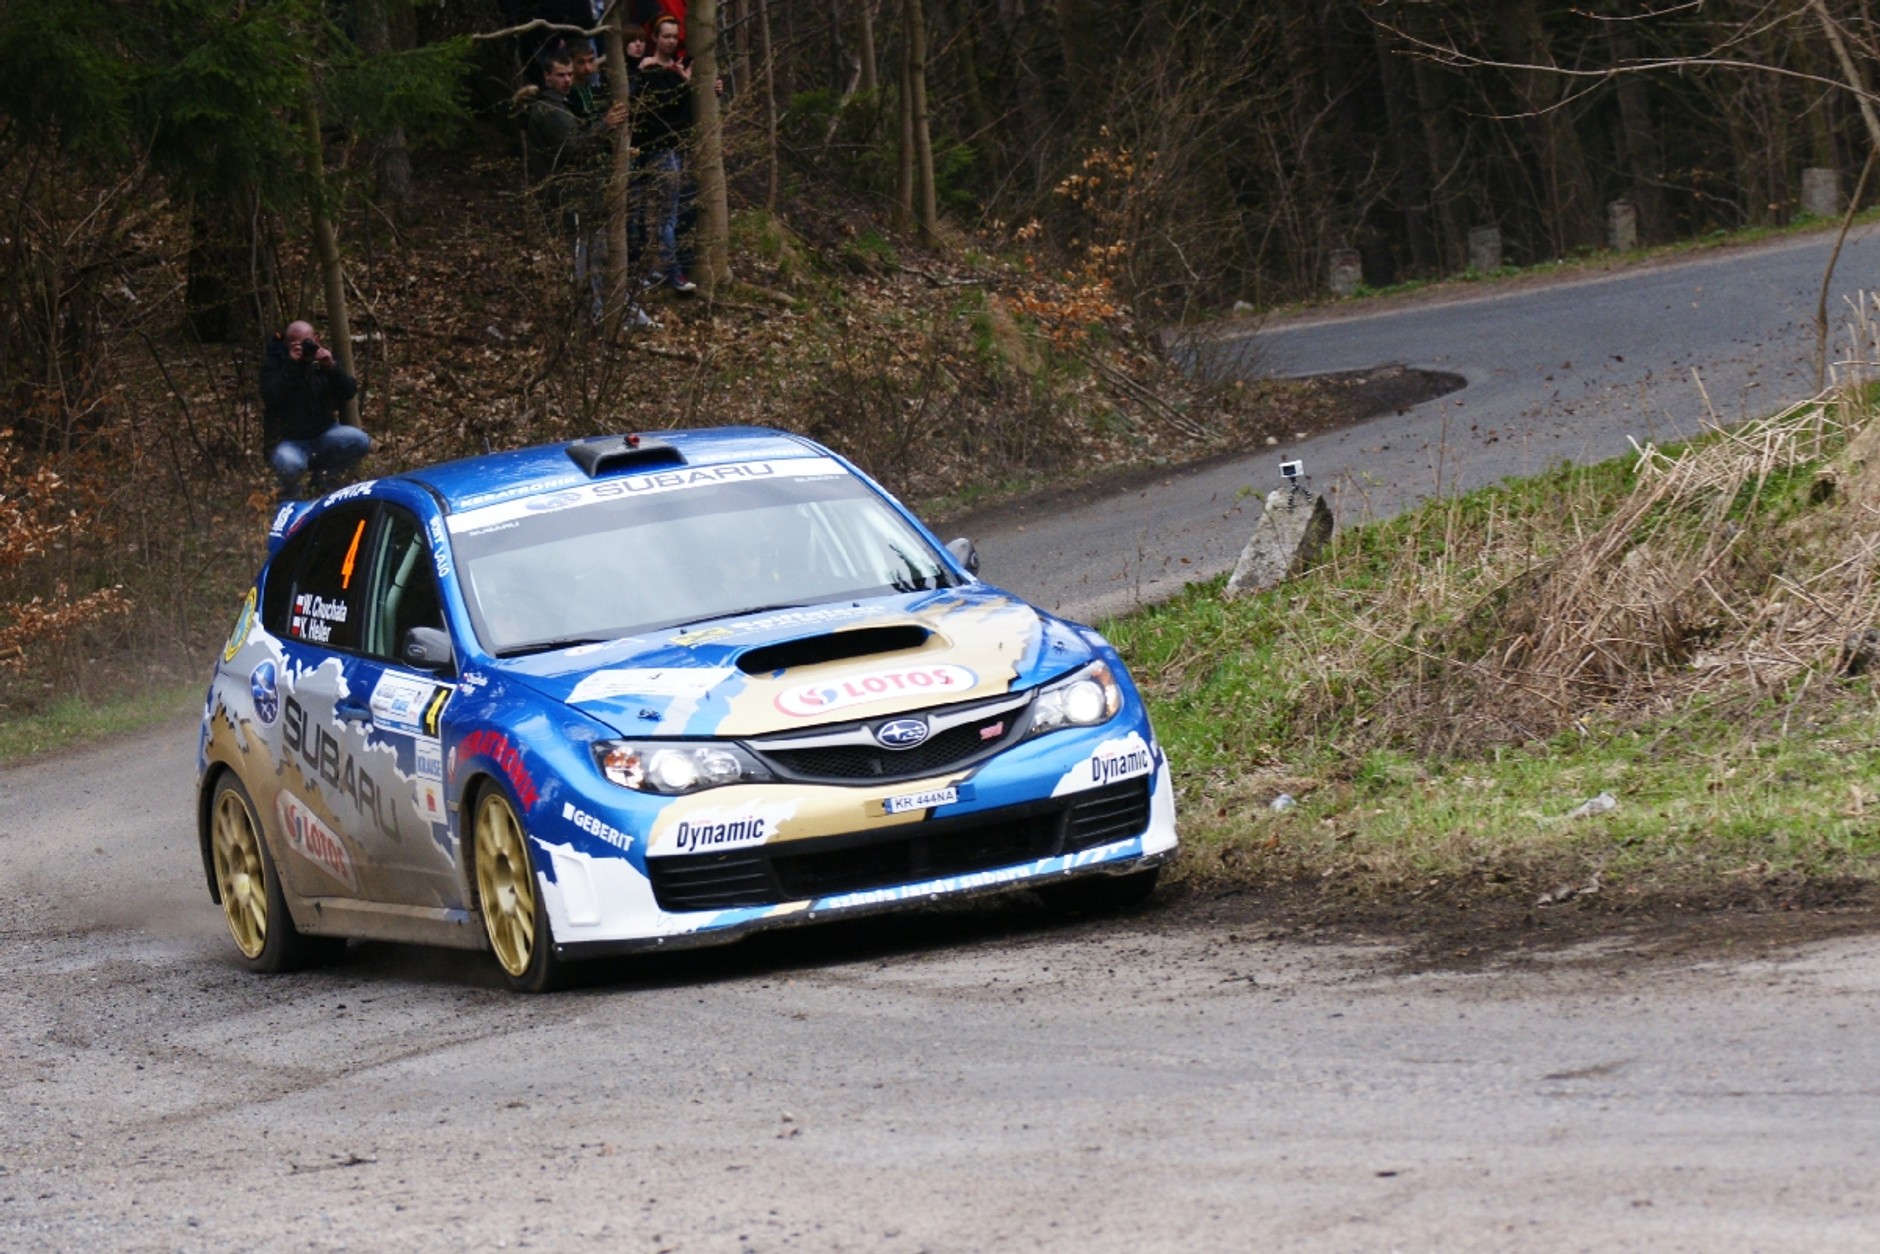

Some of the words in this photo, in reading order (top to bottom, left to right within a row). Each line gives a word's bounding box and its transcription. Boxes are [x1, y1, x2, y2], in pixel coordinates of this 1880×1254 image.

[592, 462, 775, 498] SUBARU
[434, 546, 450, 578] VAIO
[302, 593, 313, 616] W.
[308, 618, 332, 642] Heller
[842, 668, 954, 698] LOTOS
[425, 688, 448, 735] 4
[282, 694, 403, 844] SUBARU
[1092, 749, 1148, 785] Dynamic
[894, 797, 913, 809] KR
[917, 789, 955, 805] 444NA
[304, 815, 350, 880] LOTOS
[573, 809, 634, 851] GEBERIT
[676, 817, 765, 852] Dynamic
[959, 864, 1032, 889] subaru
